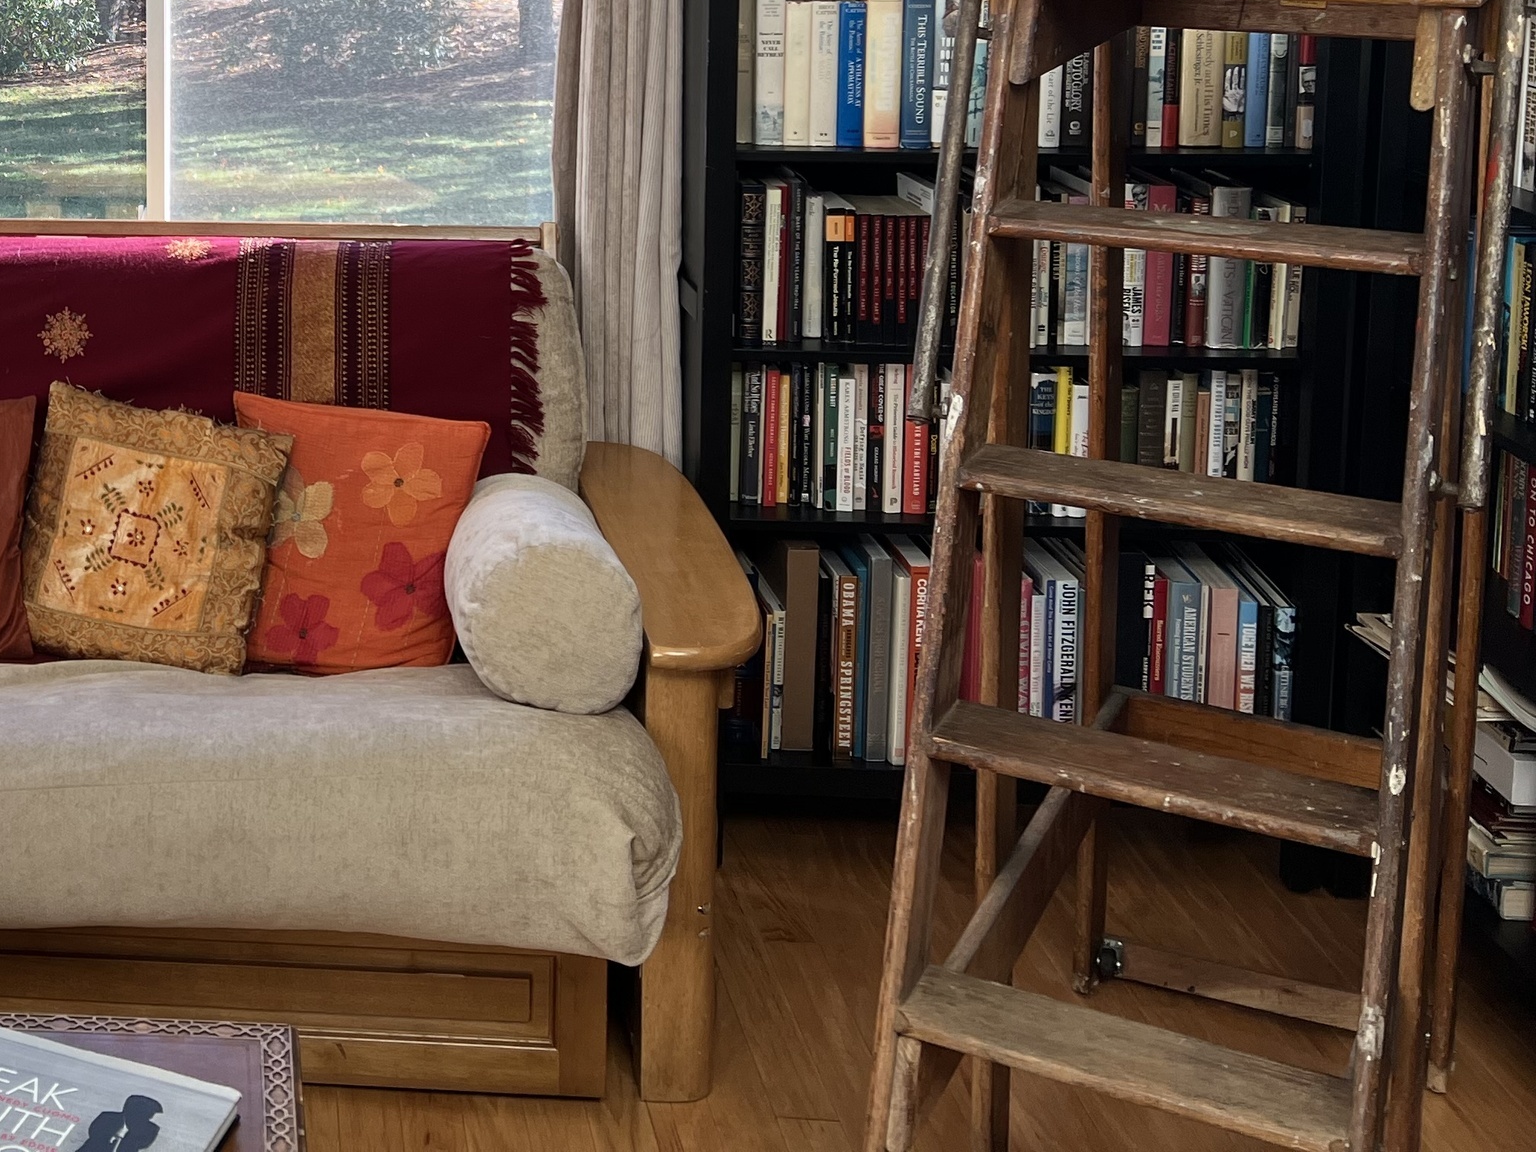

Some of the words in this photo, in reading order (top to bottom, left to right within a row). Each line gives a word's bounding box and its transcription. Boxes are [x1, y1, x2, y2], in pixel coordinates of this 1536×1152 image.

[917, 14, 928, 38] THIS
[916, 40, 927, 84] TERRIBLE
[1528, 22, 1536, 82] AMBROSE
[915, 87, 926, 124] SOUND
[1524, 91, 1532, 144] SOLDIERS
[1131, 287, 1143, 314] JAMES
[1521, 297, 1530, 350] JAWORSKI
[1529, 509, 1535, 526] TO
[1524, 535, 1534, 605] CHICAGO
[843, 583, 855, 626] OBAMA
[917, 579, 927, 617] CORITA
[1062, 583, 1075, 615] JOHN
[915, 620, 925, 647] KENT
[1155, 620, 1163, 641] Sacred
[1182, 607, 1196, 653] AMERICAN
[1241, 622, 1256, 670] TOGETHER
[1060, 620, 1075, 688] FITZGERALD
[1154, 643, 1162, 680] Encounters
[1181, 655, 1195, 700] STUDENTS
[1241, 675, 1255, 689] WE
[838, 661, 852, 748] SPRINGSTEEN
[33, 1105, 81, 1123] CUOMO
[0, 1133, 19, 1142] BY
